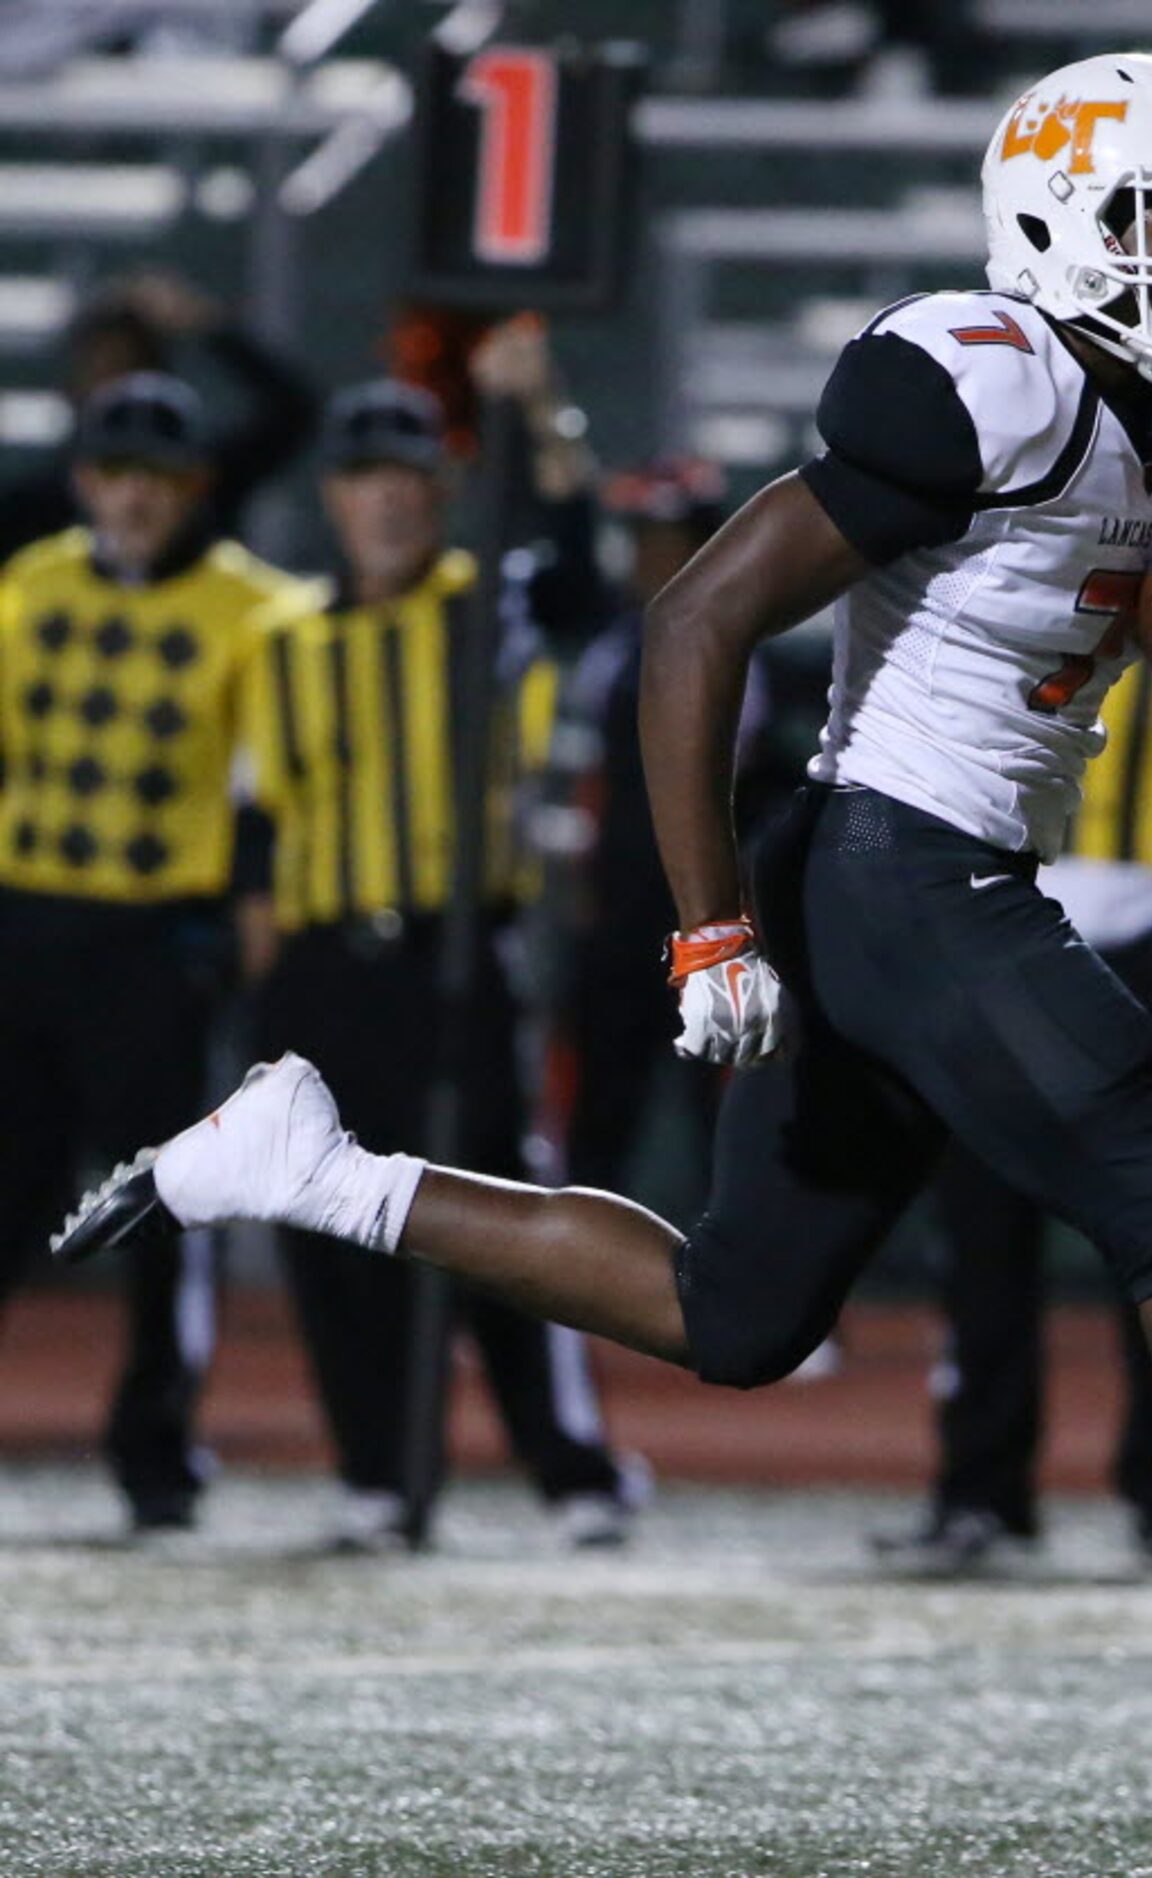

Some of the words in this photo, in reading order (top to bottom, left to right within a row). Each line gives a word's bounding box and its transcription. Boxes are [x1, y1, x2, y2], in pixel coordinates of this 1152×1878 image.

[456, 46, 557, 265] 1
[947, 310, 1036, 355] 7
[1026, 567, 1146, 716] 7
